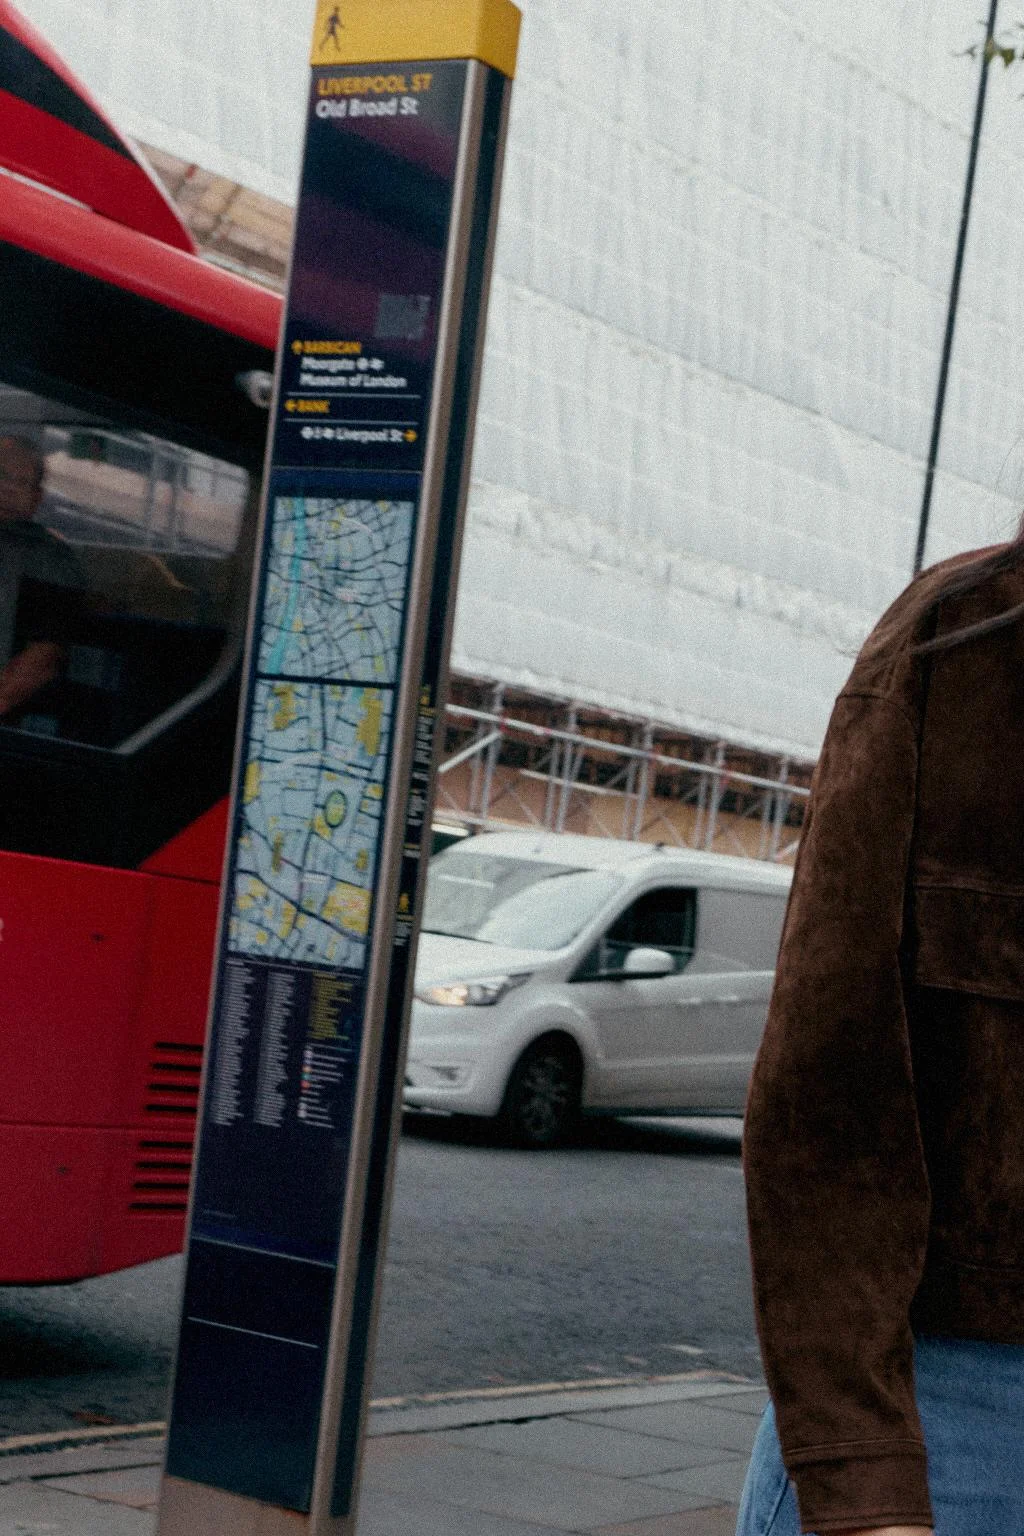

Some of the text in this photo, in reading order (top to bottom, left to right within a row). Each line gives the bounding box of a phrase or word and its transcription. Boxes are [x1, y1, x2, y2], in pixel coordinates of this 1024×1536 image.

[316, 96, 419, 118] Old Broad St
